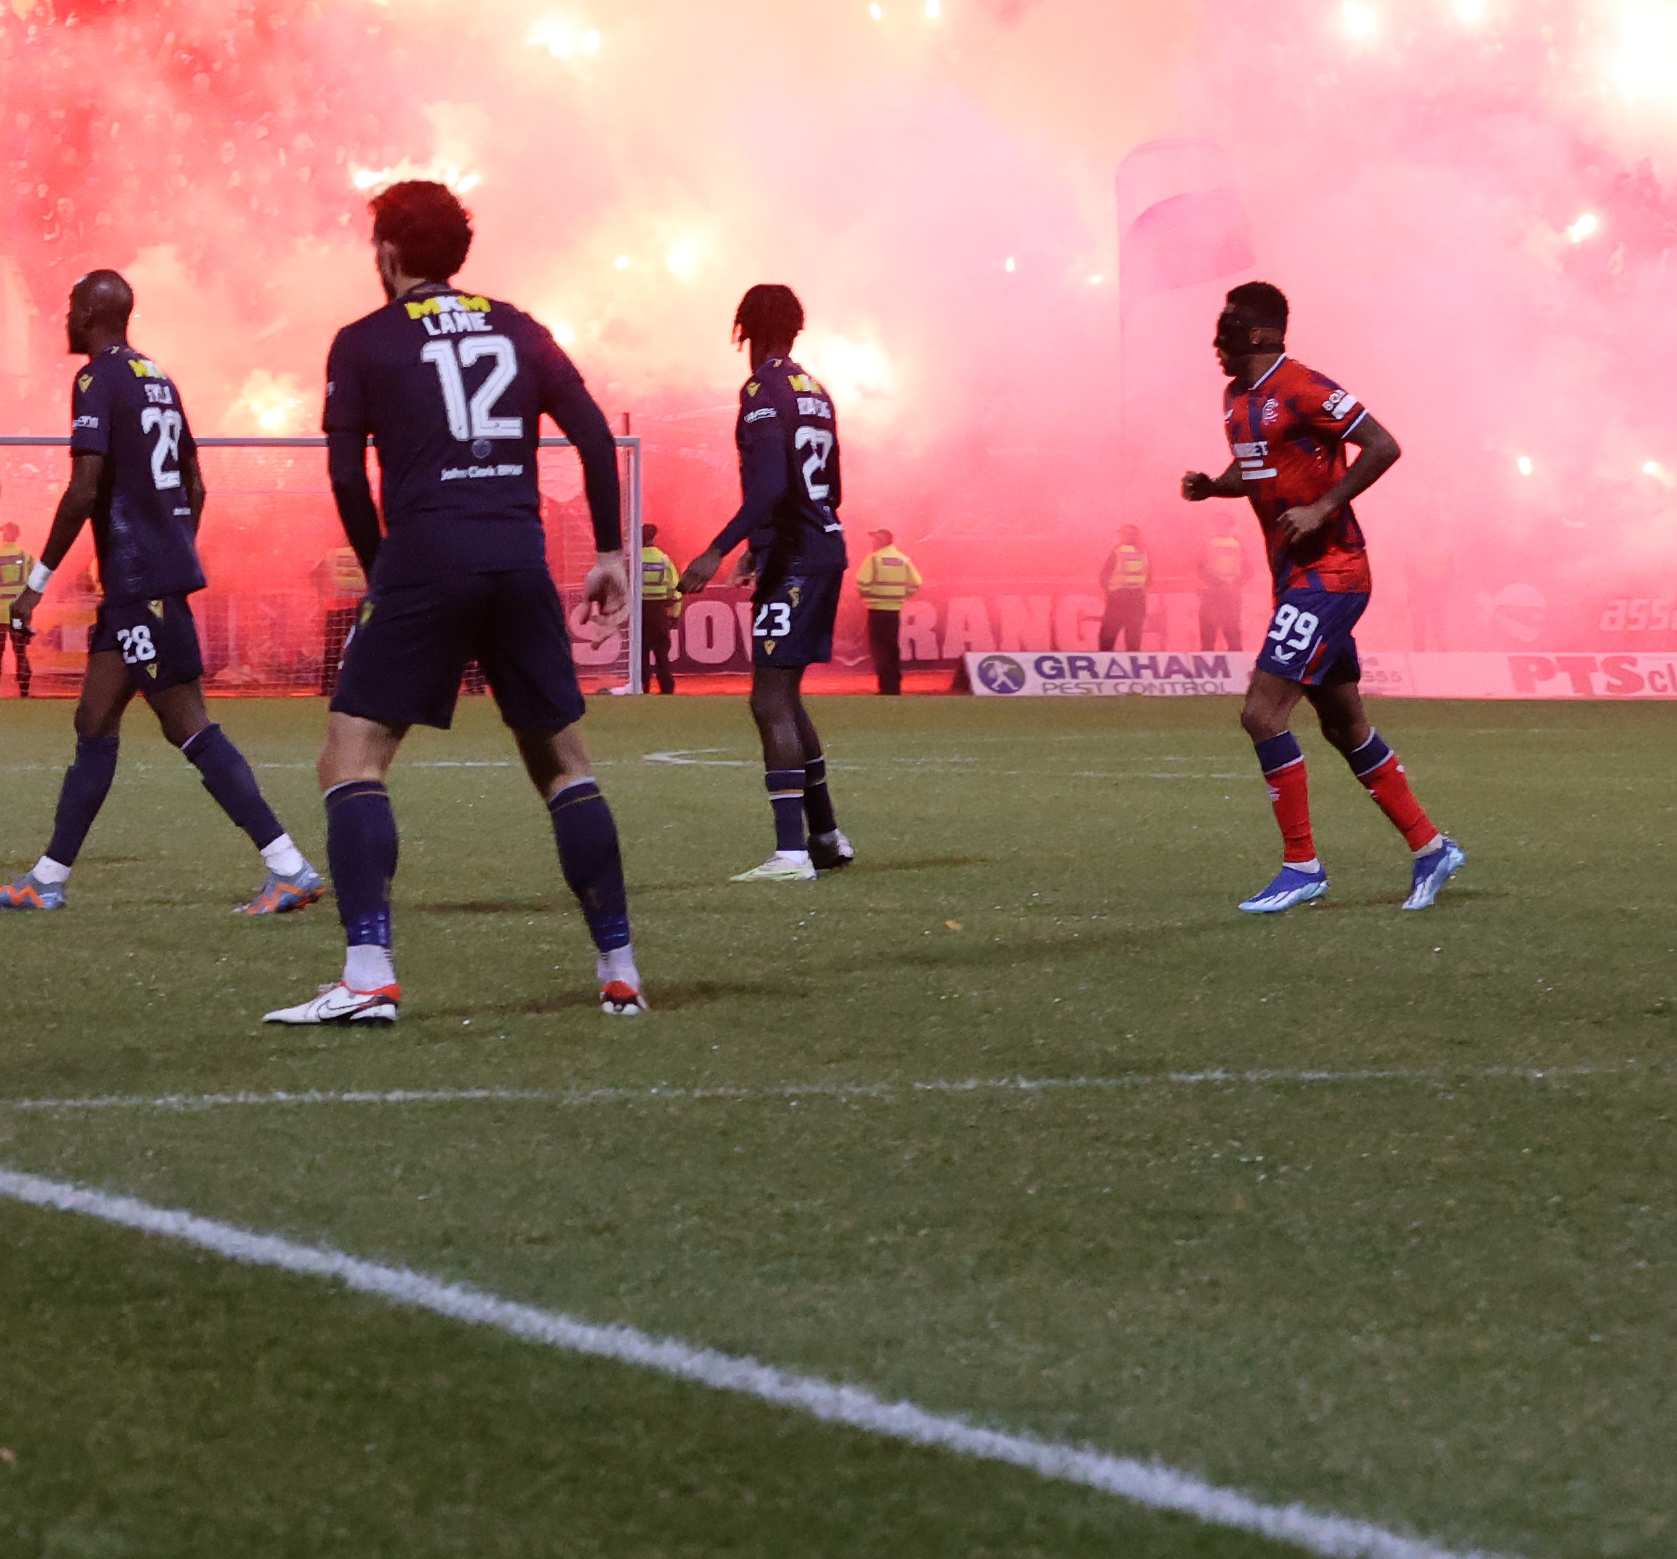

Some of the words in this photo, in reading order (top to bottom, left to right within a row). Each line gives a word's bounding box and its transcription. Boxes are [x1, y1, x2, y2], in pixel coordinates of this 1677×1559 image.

[404, 295, 492, 320] MKM
[420, 334, 524, 441] 12
[752, 602, 791, 637] 23
[1268, 603, 1319, 651] 99
[116, 625, 156, 664] 28
[1035, 655, 1233, 681] GRAHAM
[1042, 681, 1111, 696] PEST
[1114, 680, 1228, 696] CONTROL
